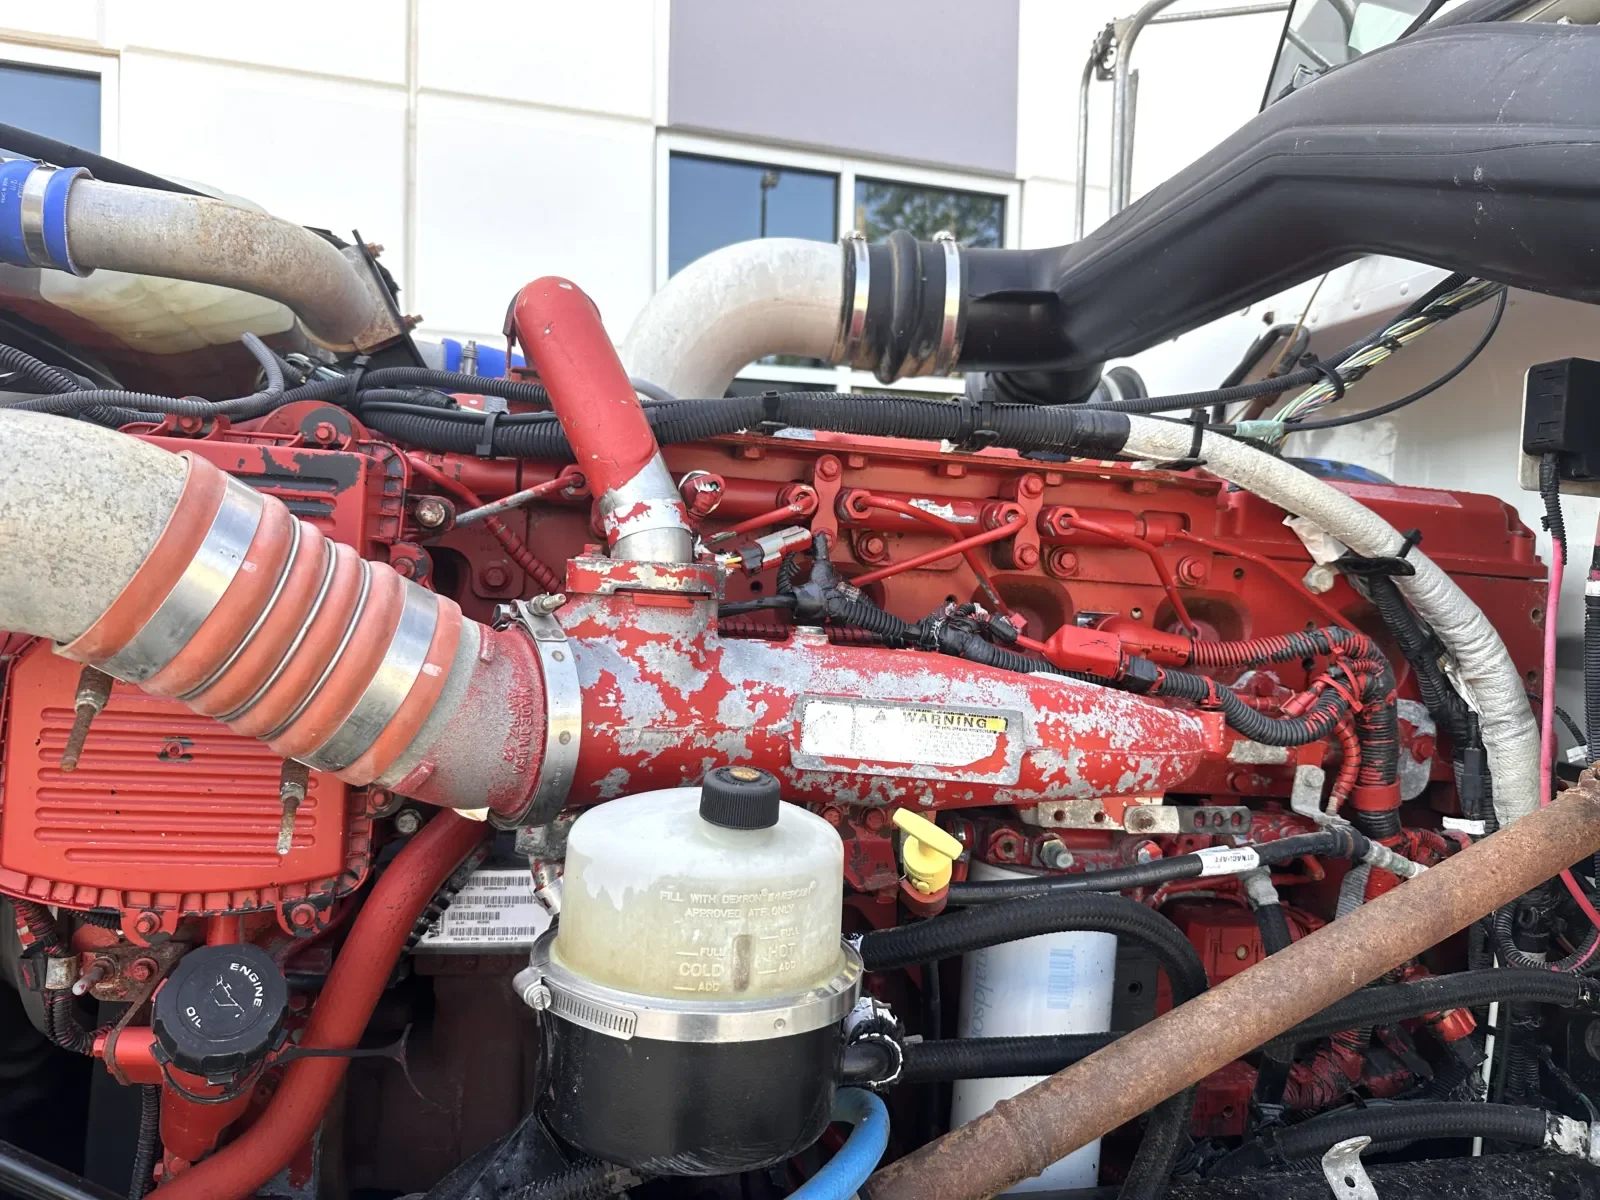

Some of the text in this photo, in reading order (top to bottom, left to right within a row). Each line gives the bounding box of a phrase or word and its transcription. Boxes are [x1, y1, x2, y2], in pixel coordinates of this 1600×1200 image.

[902, 711, 987, 729] WARNING
[659, 890, 684, 903] FILL
[690, 893, 717, 904] WITH
[684, 903, 795, 919] APPROVED ATF ONLY
[780, 927, 800, 937] FULL
[700, 947, 725, 957] FULL
[769, 943, 796, 959] HOT
[679, 962, 725, 978] COLD
[778, 960, 797, 972] ADD
[229, 962, 264, 1008] ENGINE
[698, 981, 721, 992] ADD
[186, 1006, 202, 1028] OIL
